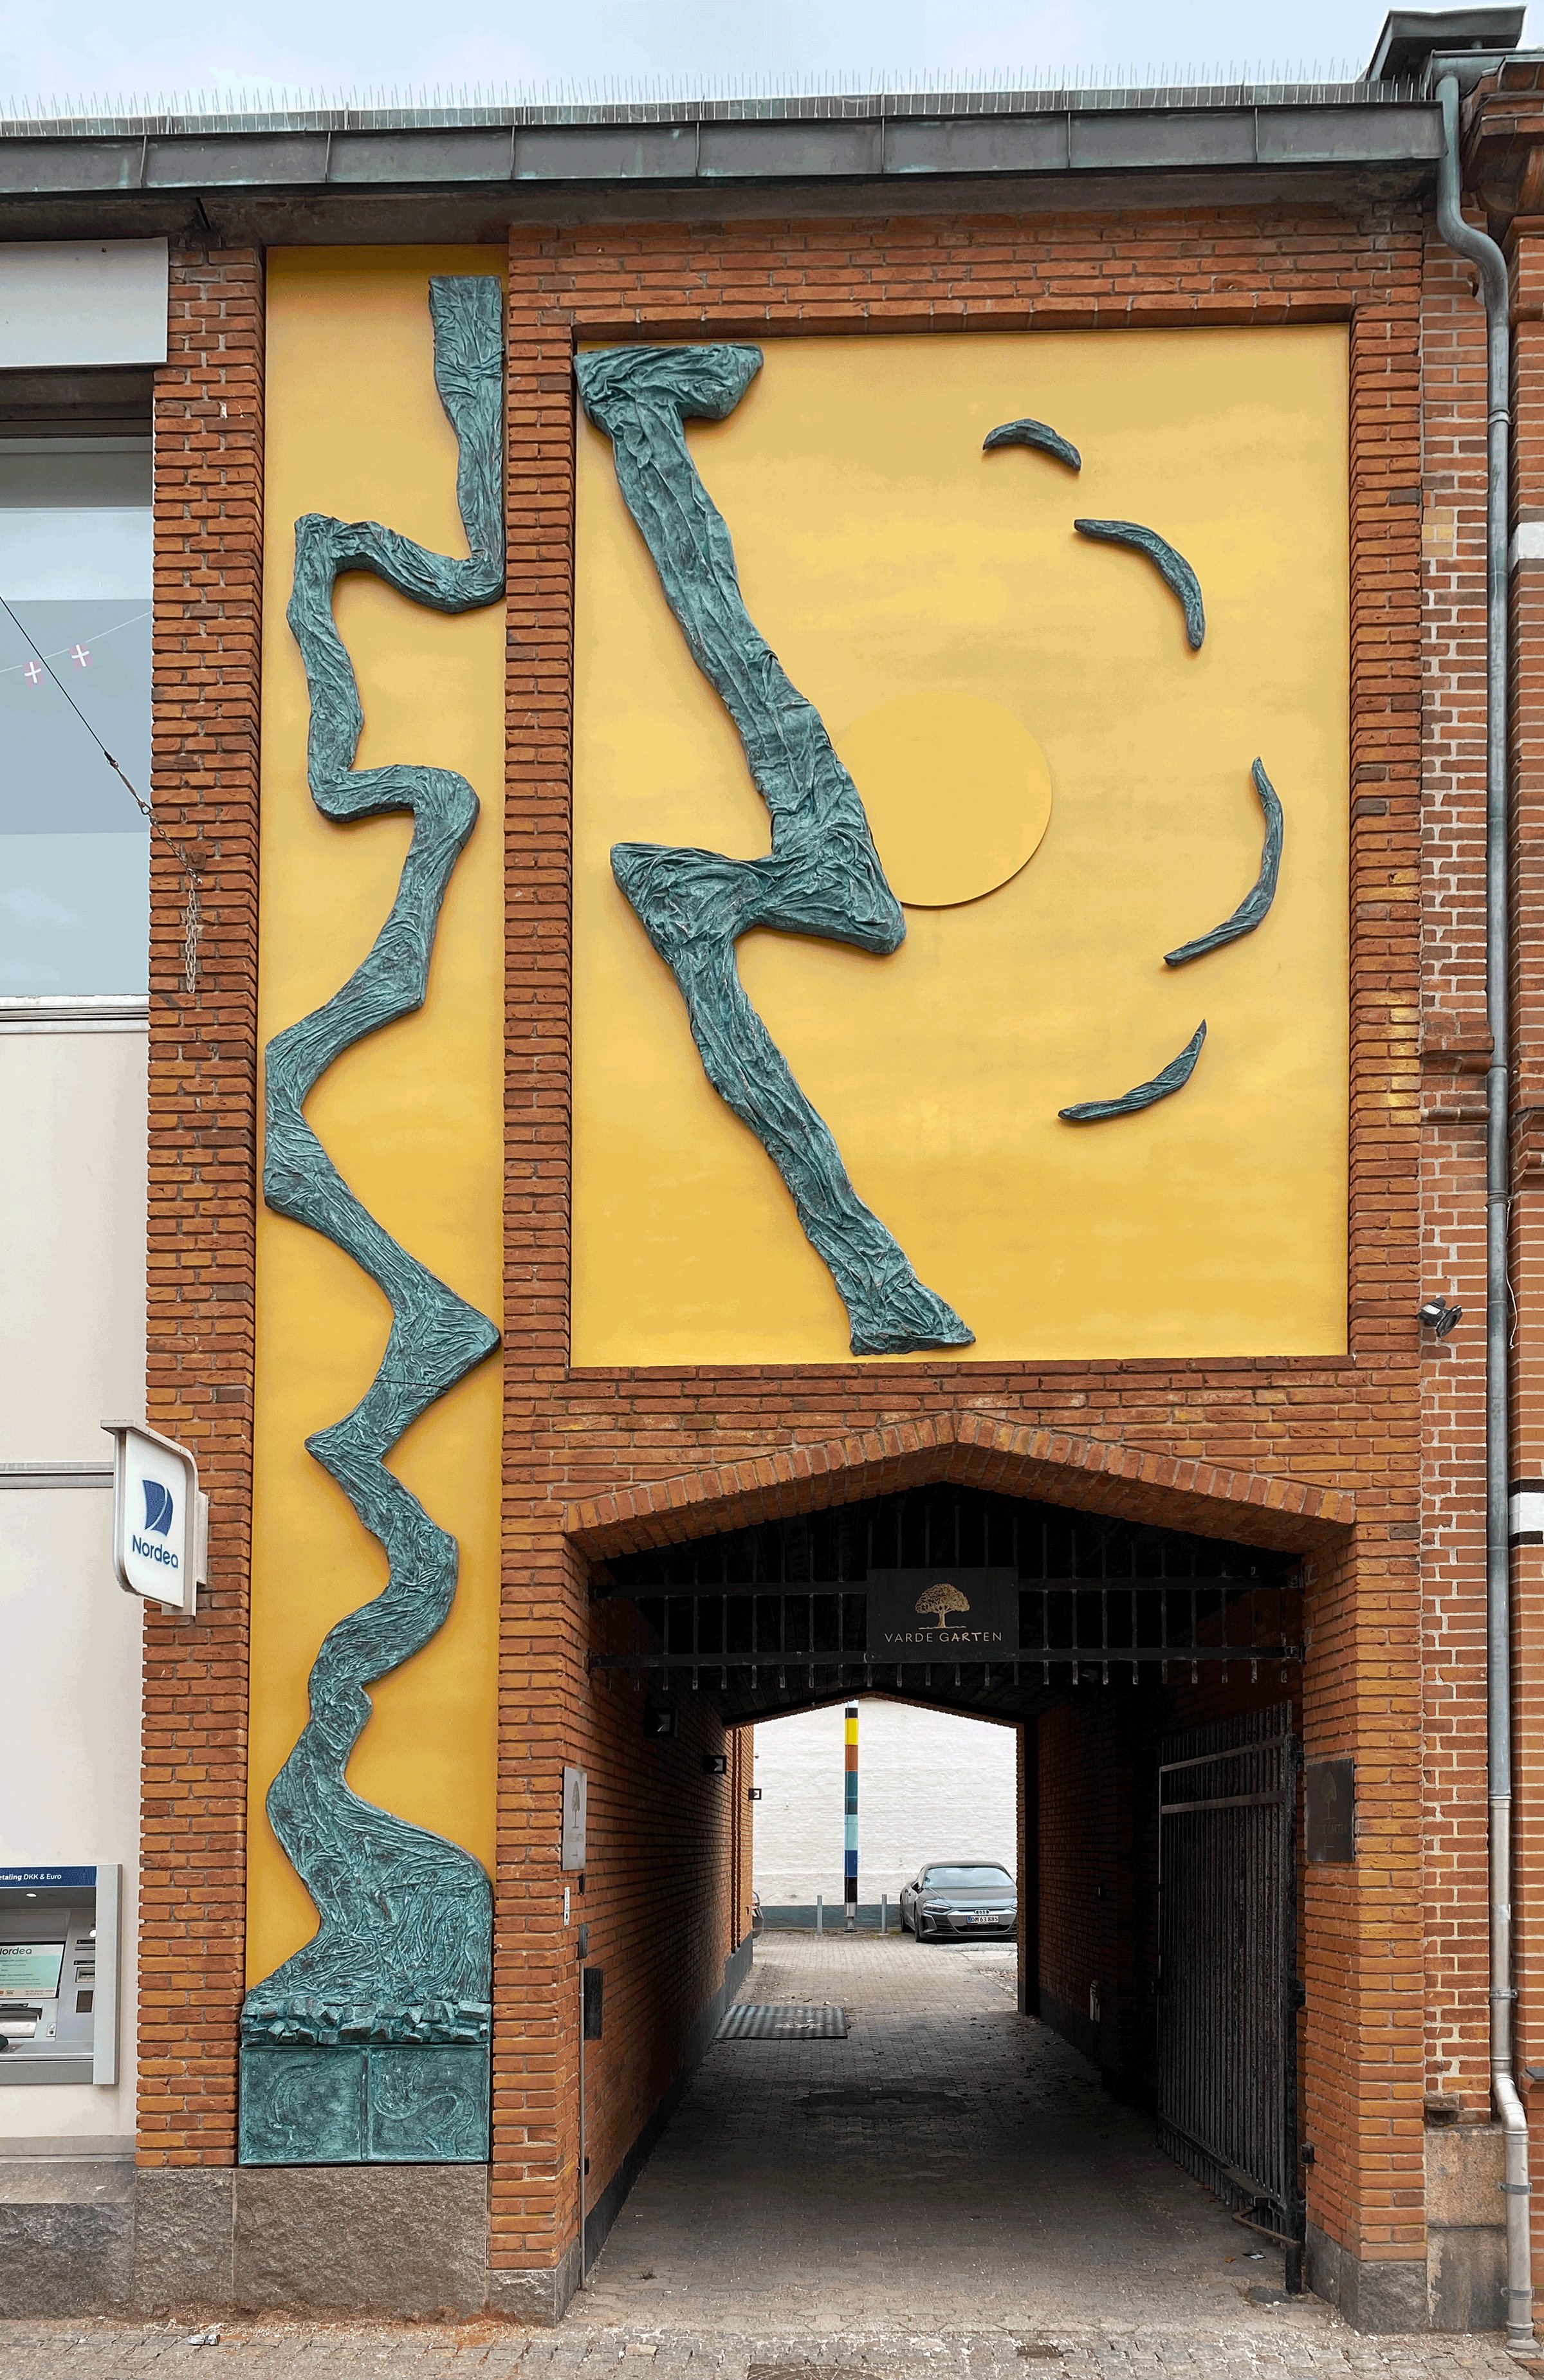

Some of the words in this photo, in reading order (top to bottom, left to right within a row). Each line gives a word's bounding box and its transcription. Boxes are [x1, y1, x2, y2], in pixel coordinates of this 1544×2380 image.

[132, 1534, 179, 1569] Nordea
[884, 1632, 933, 1643] VARDE
[939, 1632, 1002, 1643] GARTEN
